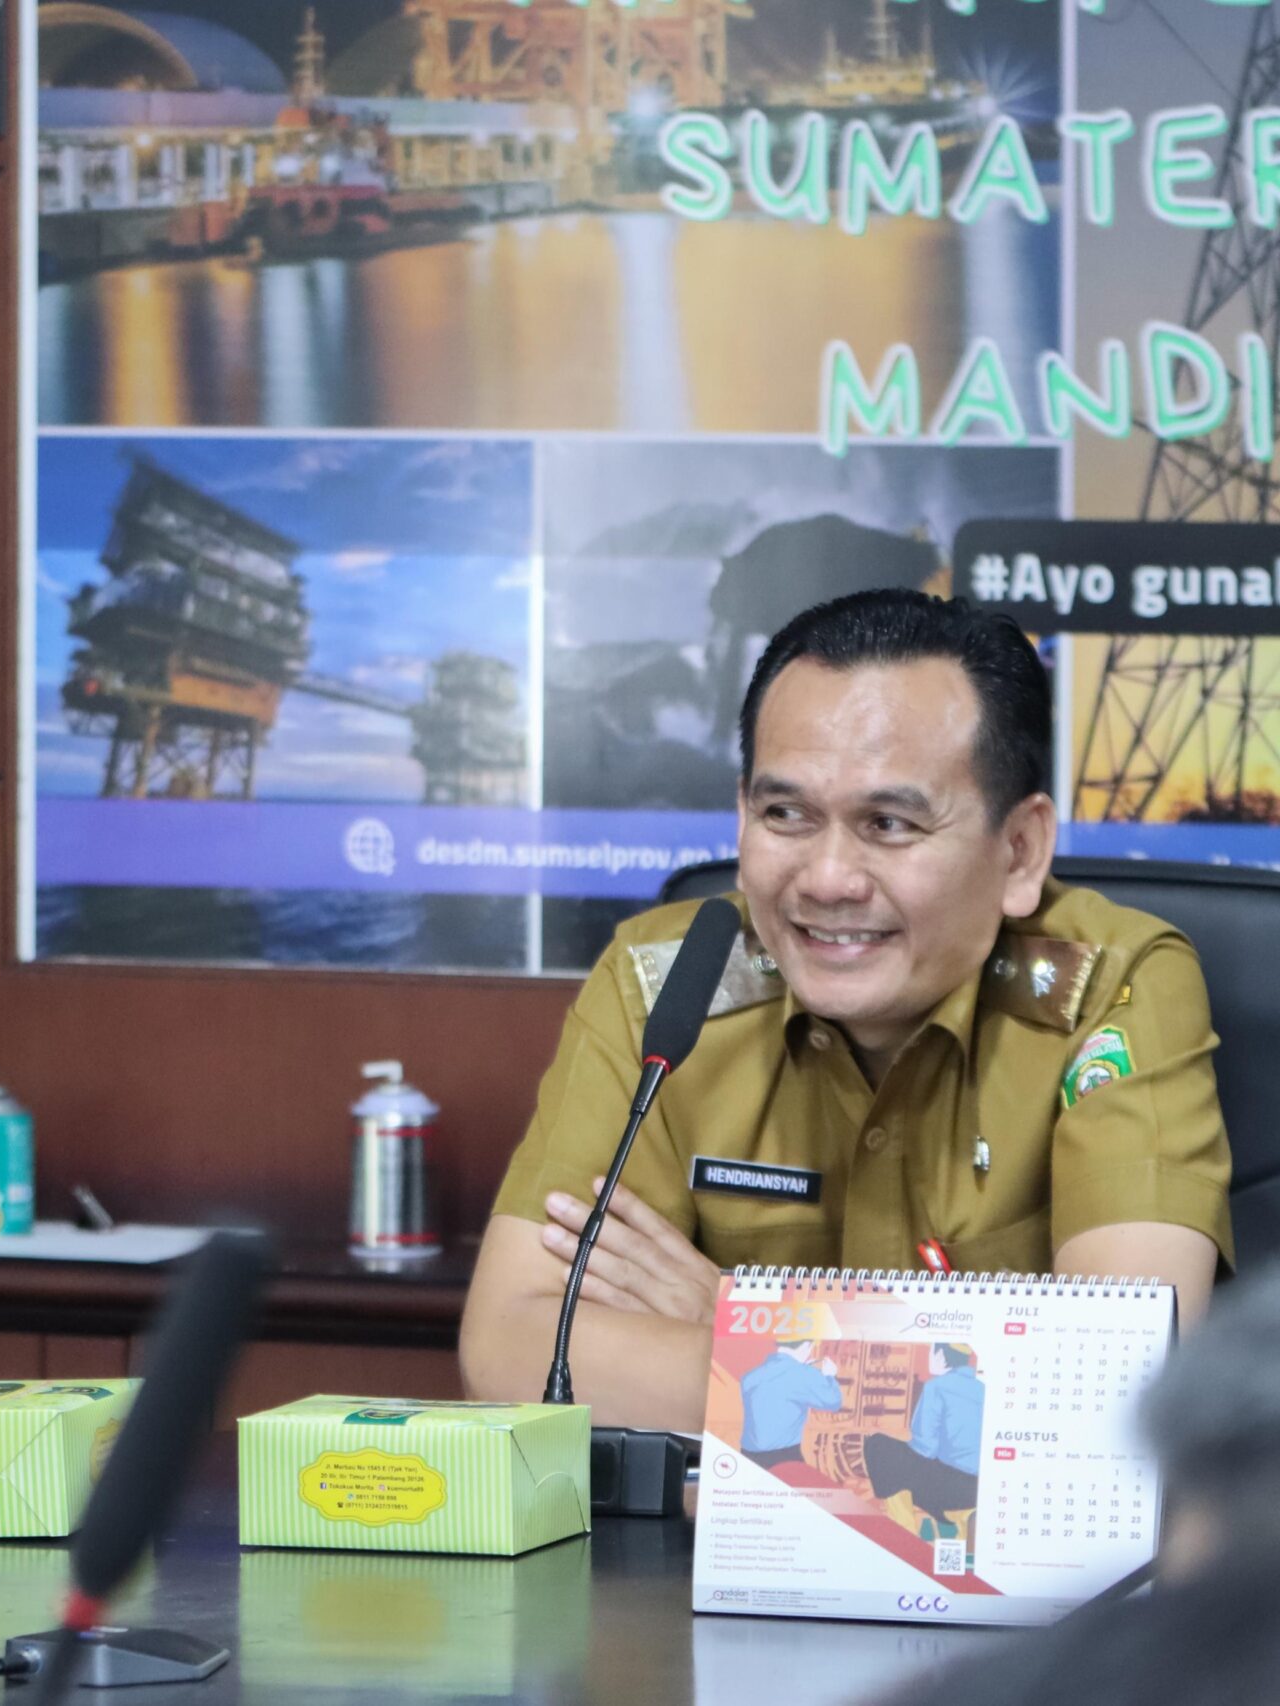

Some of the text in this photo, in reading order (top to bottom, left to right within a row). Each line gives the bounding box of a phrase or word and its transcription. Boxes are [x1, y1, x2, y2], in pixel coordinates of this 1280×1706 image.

[971, 553, 1280, 618] #Ayo guna
[705, 1165, 809, 1194] HENDRIANSYAH
[728, 1306, 816, 1334] 2025
[1006, 1306, 1040, 1317] JULI
[994, 1431, 1059, 1442] AGUSTUS
